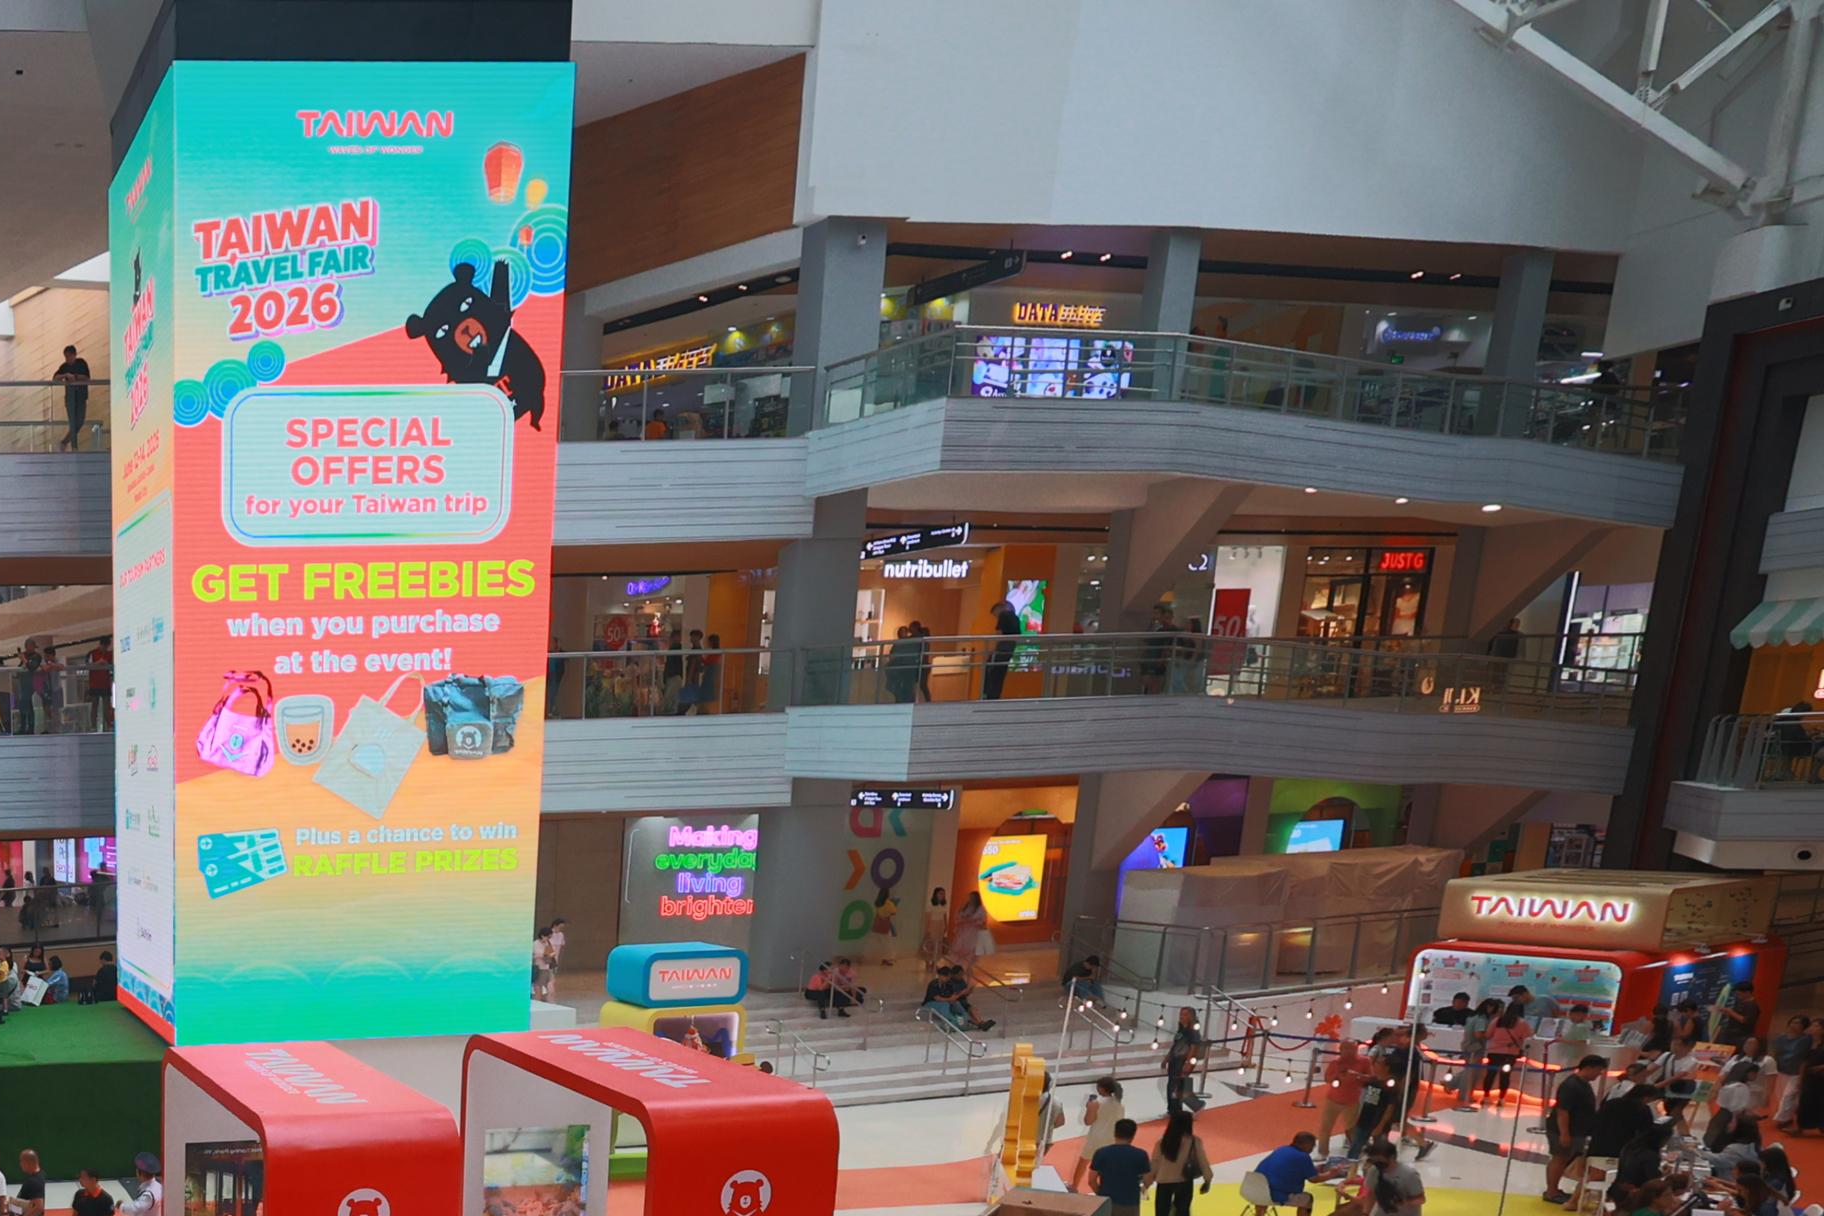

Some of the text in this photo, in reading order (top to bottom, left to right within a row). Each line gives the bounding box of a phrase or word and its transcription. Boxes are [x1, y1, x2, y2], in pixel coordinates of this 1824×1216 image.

[297, 110, 454, 137] TAIWAN
[193, 198, 377, 261] TAIWAN
[195, 244, 375, 294] TRAVEL FAIR
[229, 284, 343, 338] 2026
[286, 417, 452, 448] SPECIAL
[291, 455, 445, 486] OFFERS
[245, 492, 488, 519] for your Taiwan trip
[884, 559, 968, 578] nutribullet
[1381, 552, 1425, 570] JUST G
[192, 559, 536, 603] GET FREEBIES
[227, 609, 500, 640] when you purchase
[274, 647, 453, 674] at the event!
[296, 821, 517, 846] Plus a chance to win
[669, 825, 758, 850] Making
[294, 847, 519, 877] RAFFLE PRIZES
[677, 872, 743, 897] living
[660, 895, 754, 920] brighter
[1471, 896, 1632, 922] TAIWAN
[659, 968, 733, 983] TAIWAN
